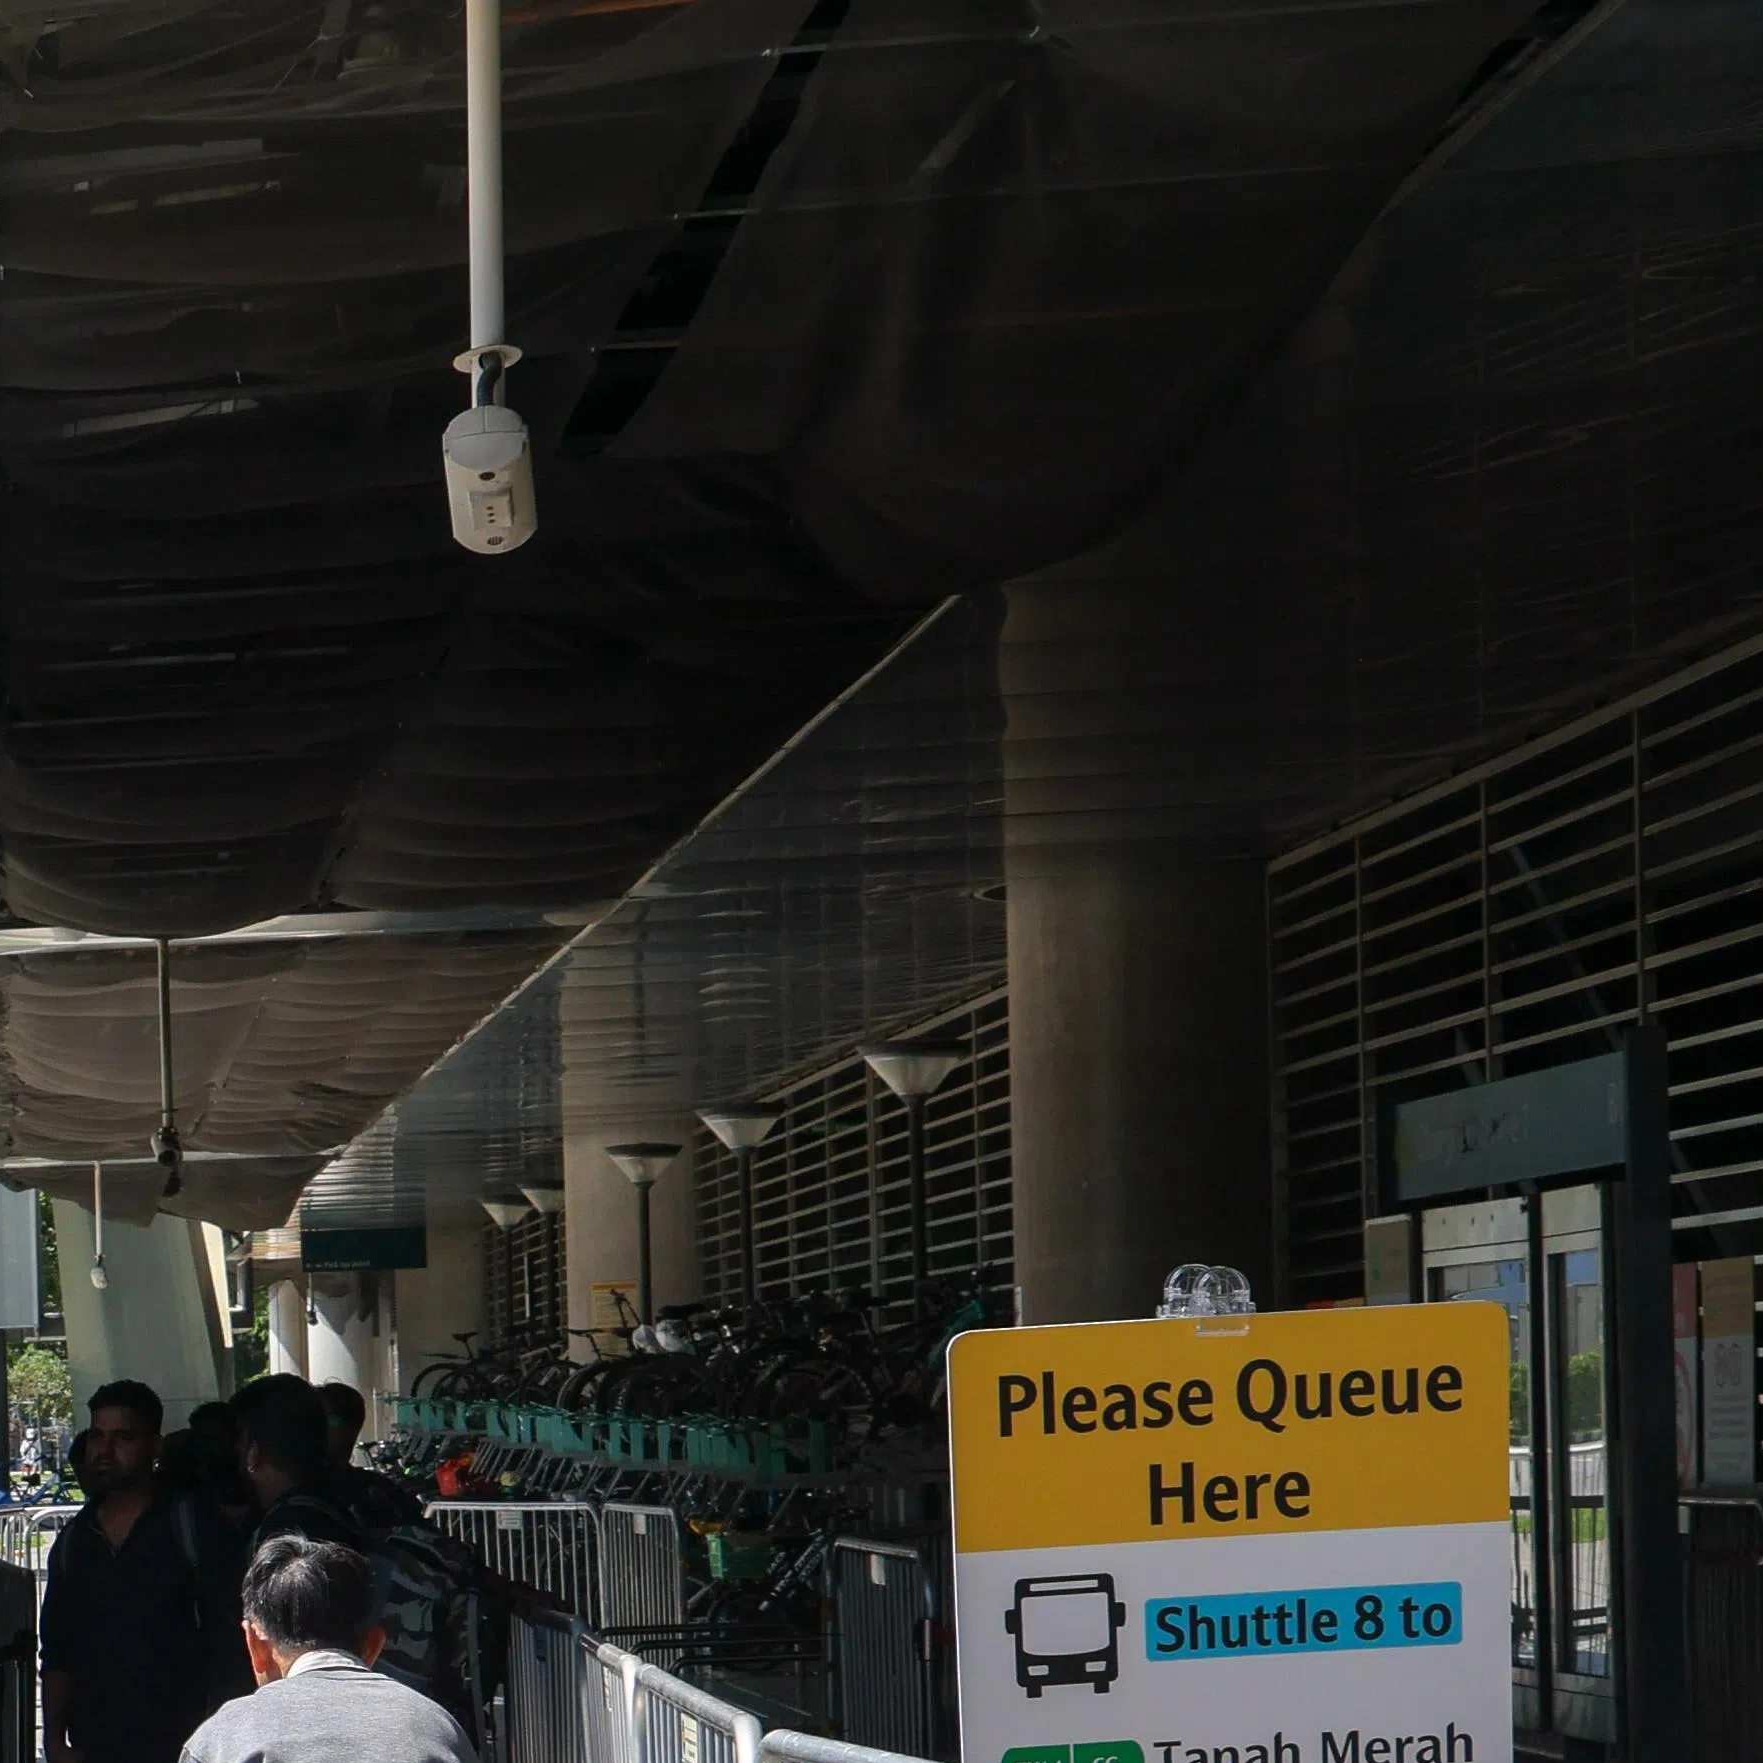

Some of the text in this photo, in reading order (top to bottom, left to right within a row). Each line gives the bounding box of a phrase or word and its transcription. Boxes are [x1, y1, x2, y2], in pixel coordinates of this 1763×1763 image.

[998, 1357, 1465, 1438] Please Queue
[1148, 1462, 1313, 1526] Here
[1156, 1595, 1453, 1654] Shuttle 8 to
